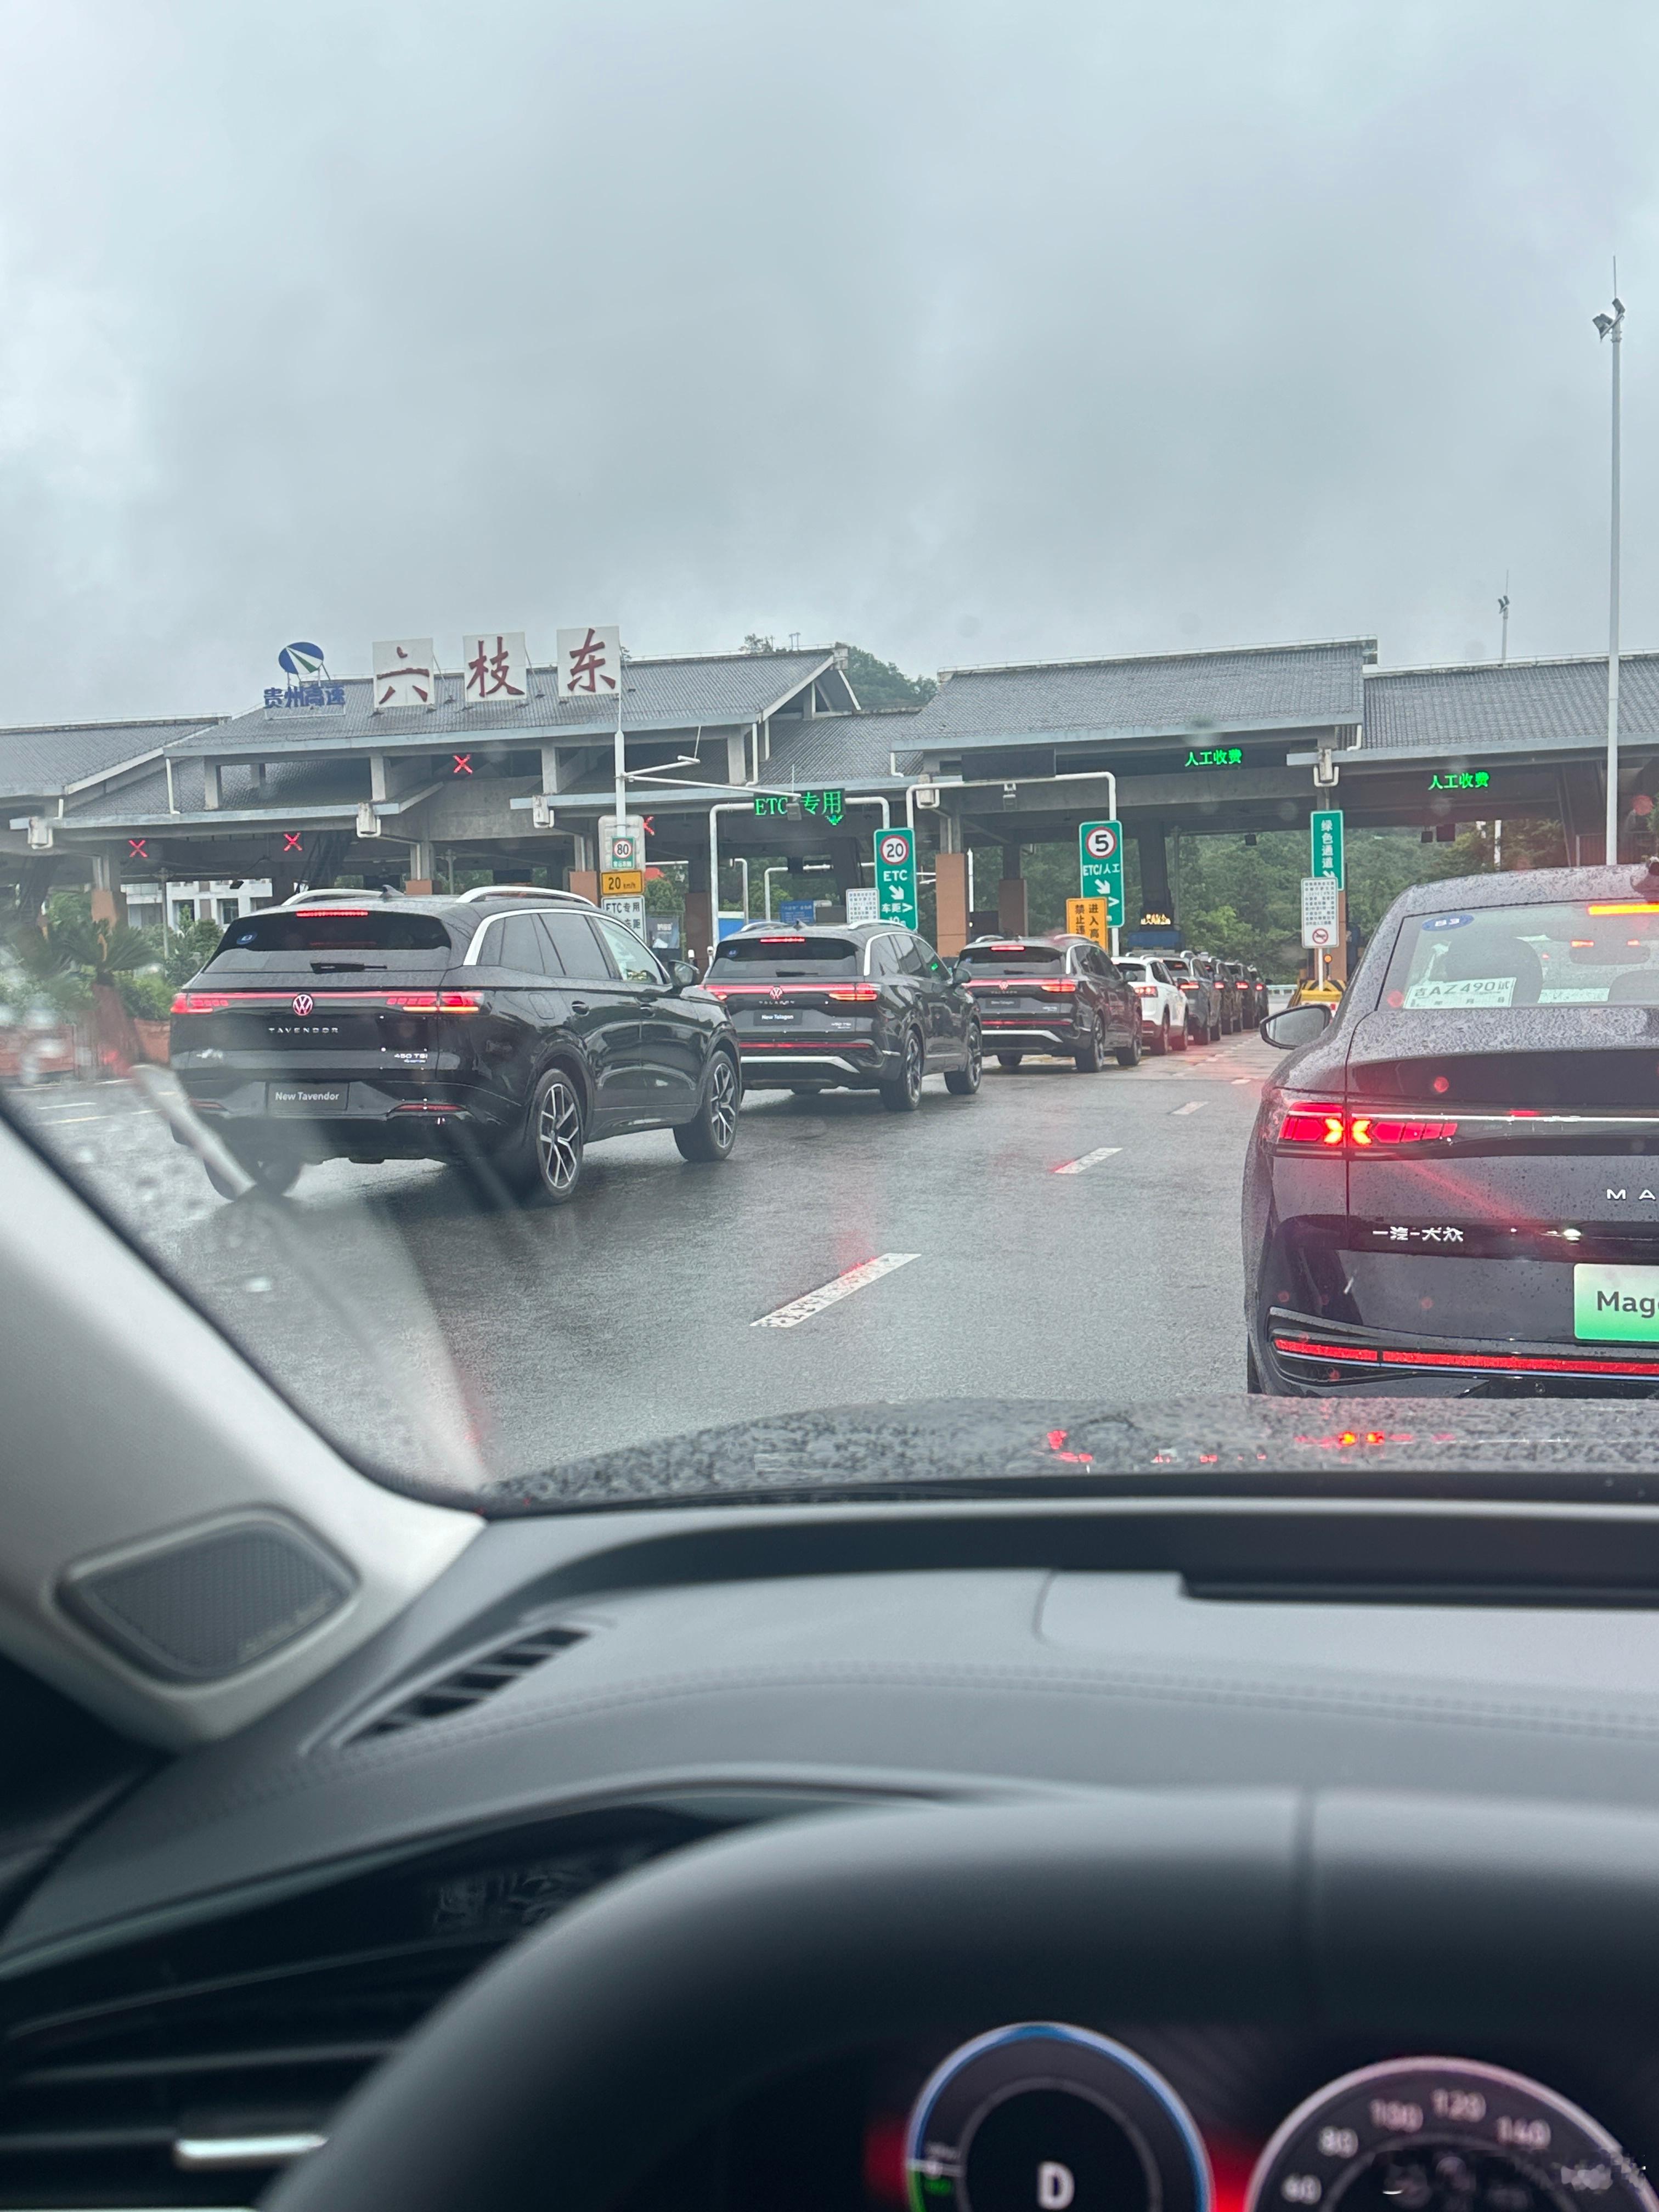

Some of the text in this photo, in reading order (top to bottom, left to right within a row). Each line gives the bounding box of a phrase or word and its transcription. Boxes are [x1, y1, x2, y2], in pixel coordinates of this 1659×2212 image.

[376, 628, 616, 704] 六枝东
[263, 684, 346, 708] 贵州高速
[1184, 748, 1242, 767] 人工收费
[1427, 771, 1489, 790] 人工收费
[755, 791, 841, 815] ETC 专用
[617, 844, 629, 855] 80
[887, 843, 904, 858] 20
[1095, 834, 1109, 852] 5
[608, 877, 621, 890] 20
[883, 870, 908, 882] ETC
[1088, 903, 1099, 943] 进入高
[275, 1091, 340, 1101] New Tavendor
[1606, 1188, 1656, 1200] MA
[1596, 1290, 1659, 1318] Mag
[1037, 2160, 1075, 2210] D
